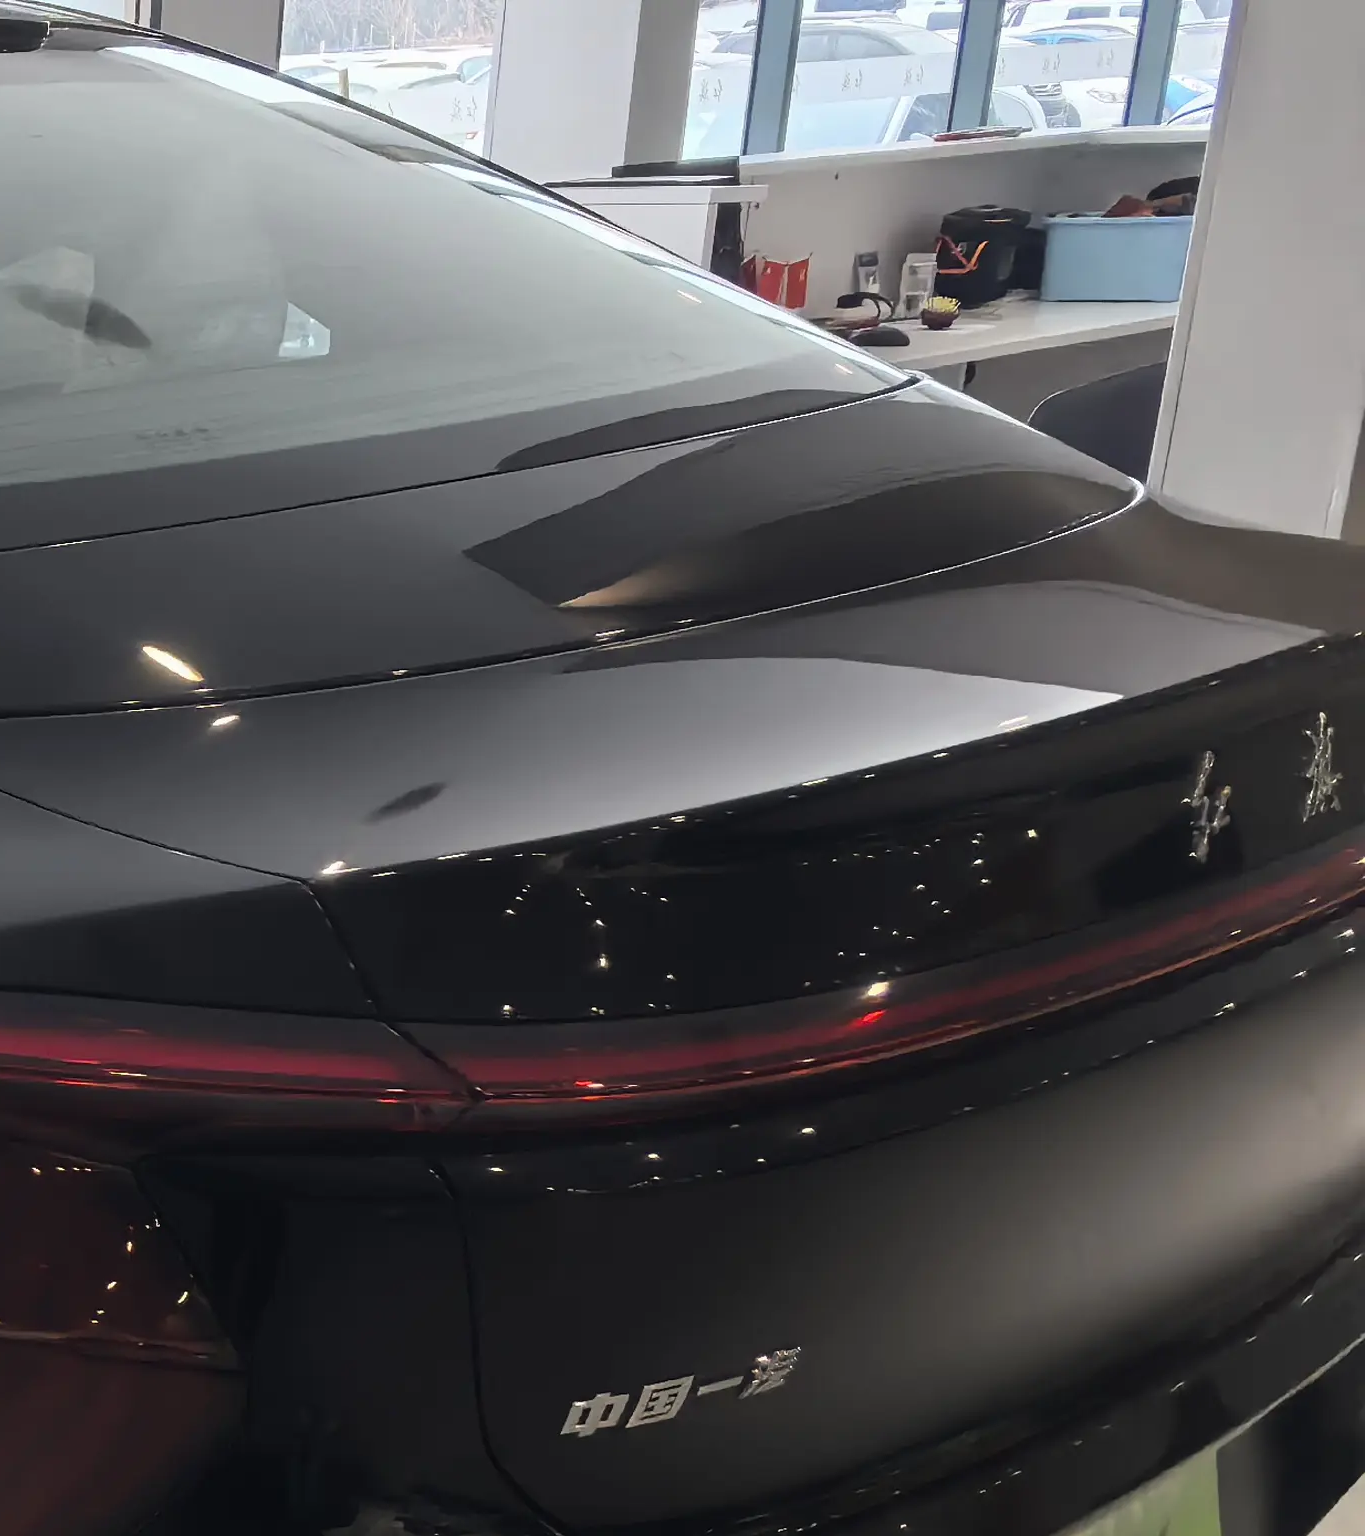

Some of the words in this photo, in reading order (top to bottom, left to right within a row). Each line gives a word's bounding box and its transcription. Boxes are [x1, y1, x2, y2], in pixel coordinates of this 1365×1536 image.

[1181, 712, 1344, 863] 红旗
[559, 1346, 802, 1438] 中国一汽
